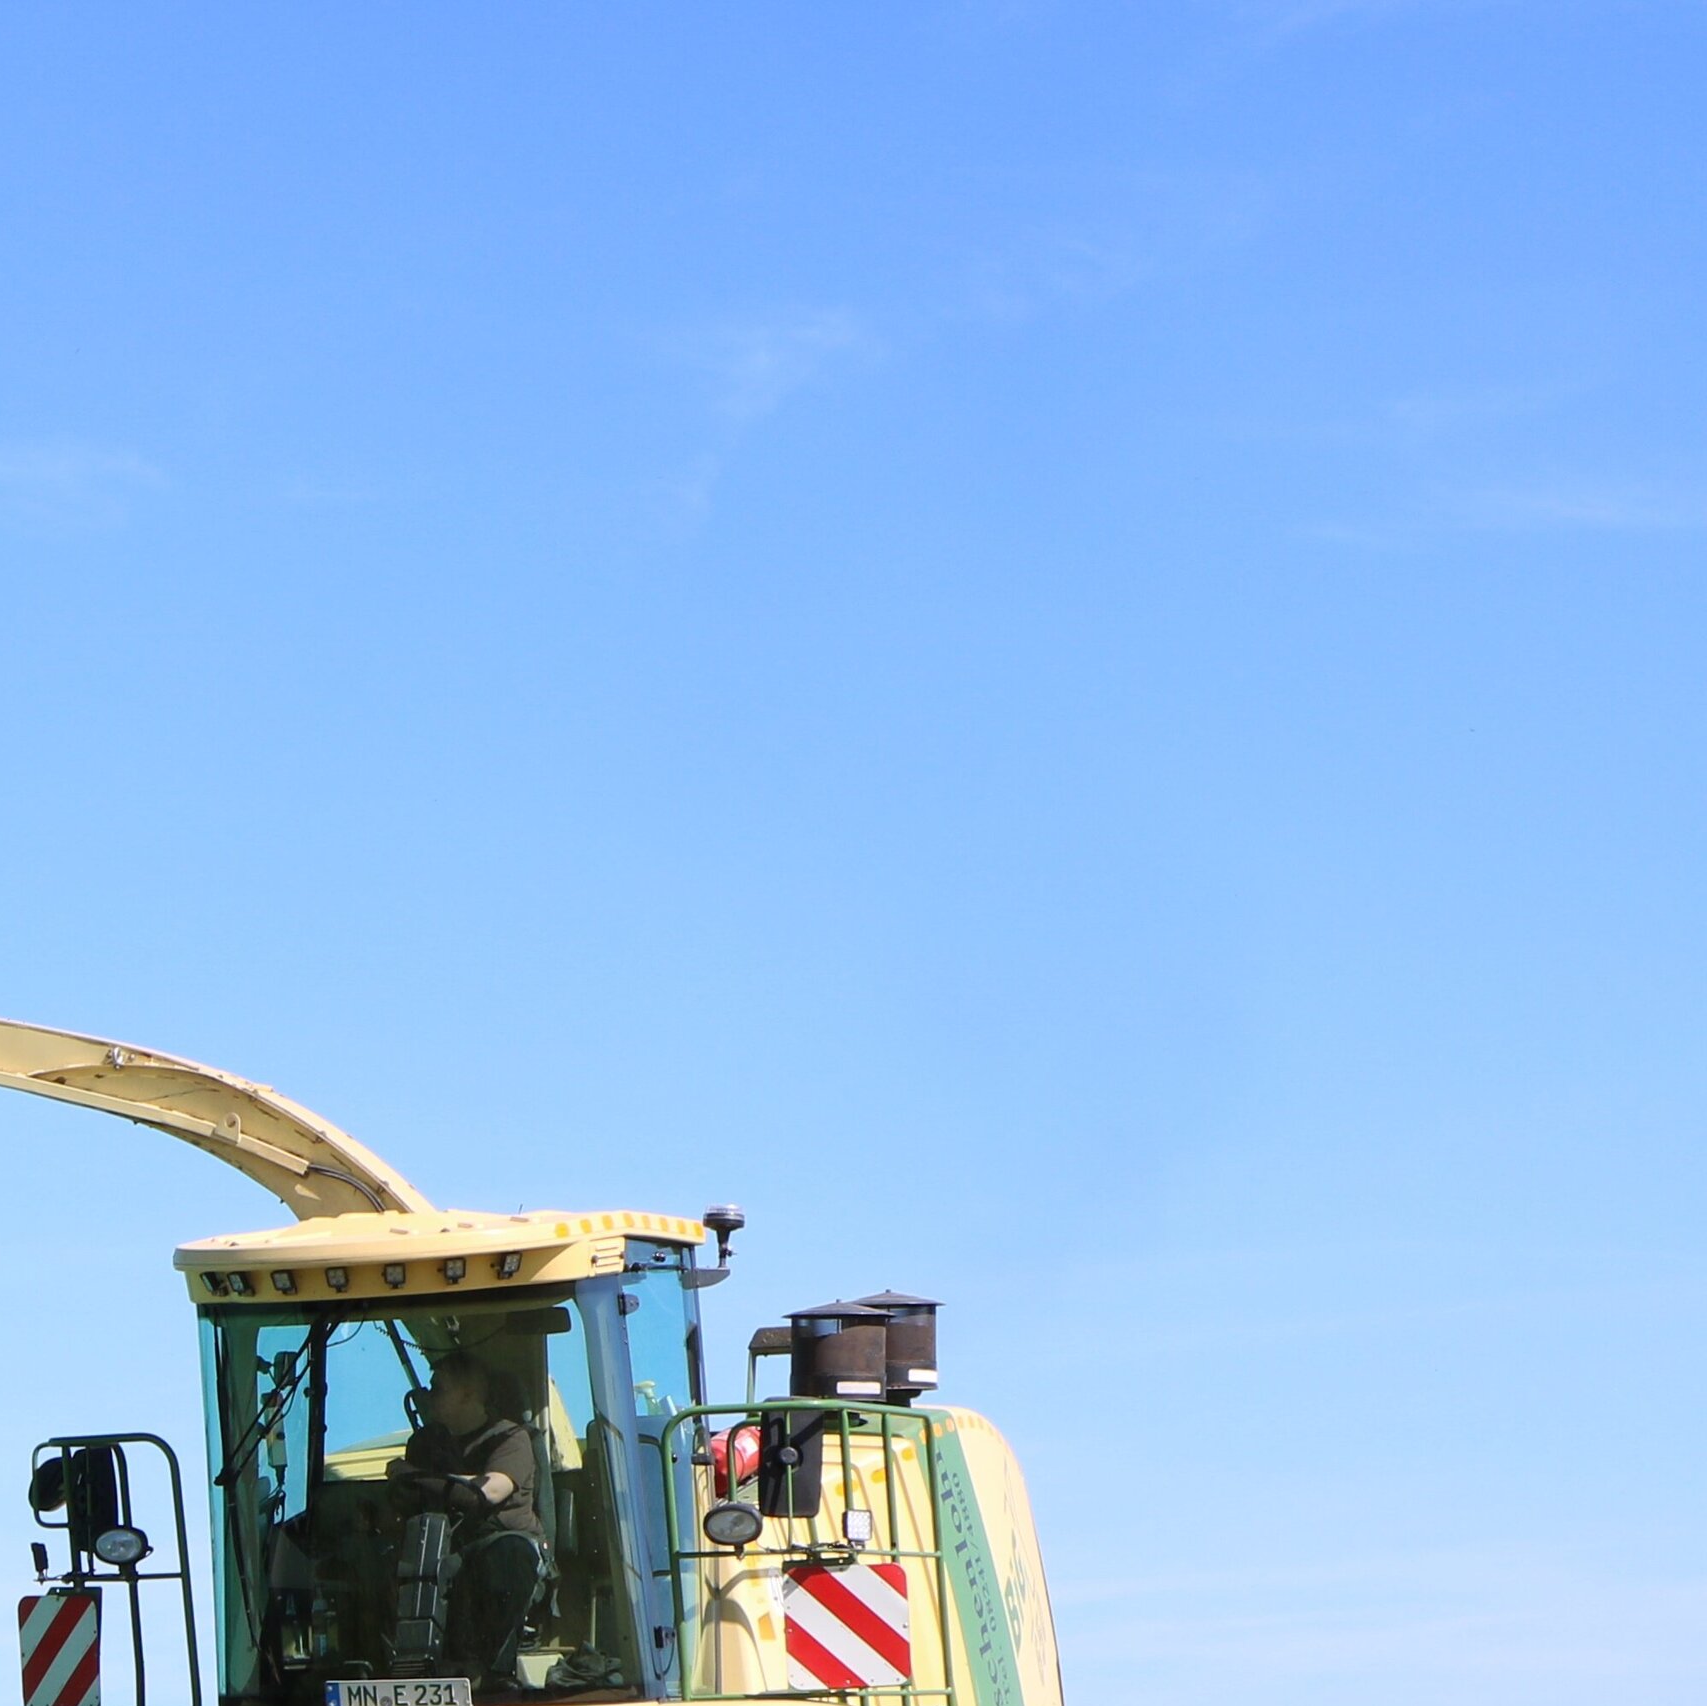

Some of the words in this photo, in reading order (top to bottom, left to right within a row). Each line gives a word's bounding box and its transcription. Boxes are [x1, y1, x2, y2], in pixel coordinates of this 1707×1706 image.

[347, 1685, 378, 1706] MN
[393, 1685, 409, 1706] E
[414, 1684, 458, 1706] 231
